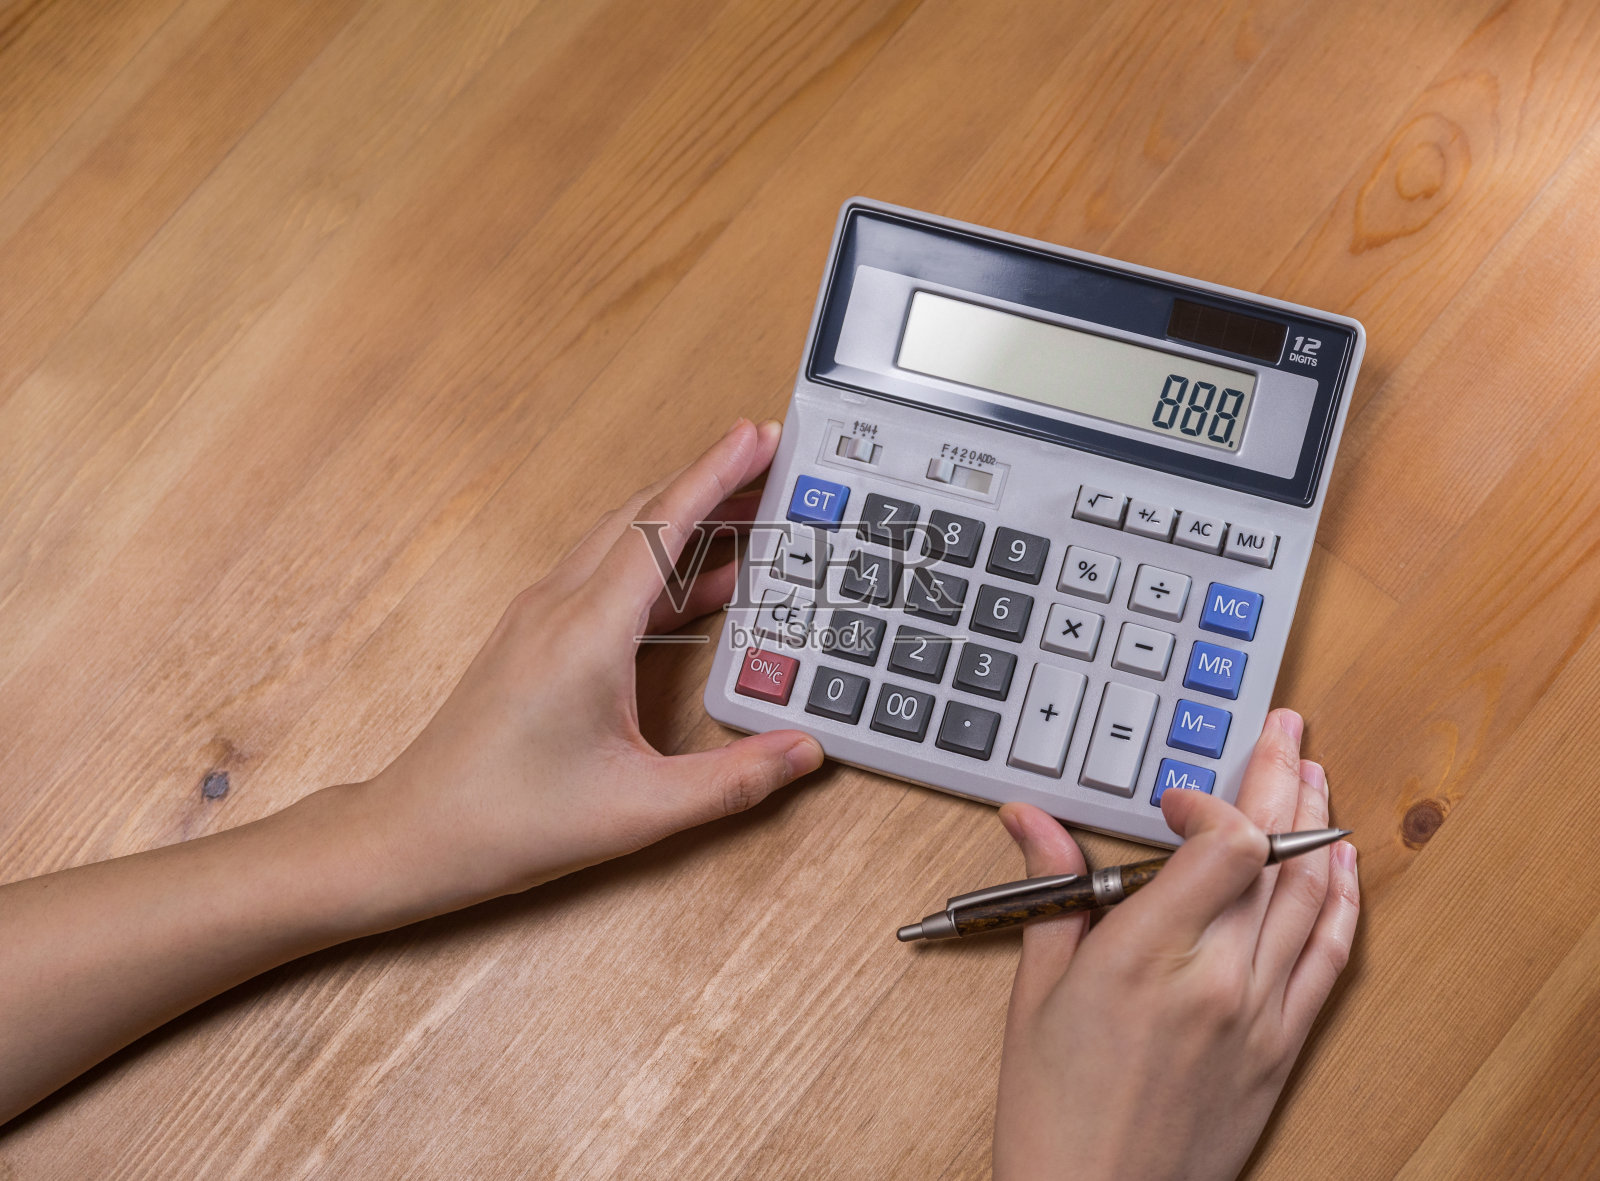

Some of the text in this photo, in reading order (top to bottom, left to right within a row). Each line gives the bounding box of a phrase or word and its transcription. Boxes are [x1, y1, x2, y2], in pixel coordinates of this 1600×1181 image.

[1293, 336, 1322, 356] 12
[1289, 352, 1318, 367] DIGITS
[951, 446, 959, 456] 4
[959, 448, 968, 459] 2
[803, 488, 836, 511] GT
[880, 504, 899, 527] 7
[943, 522, 962, 545] 8
[1189, 520, 1213, 538] AC
[1008, 539, 1027, 563] 9
[1236, 532, 1265, 550] MU
[861, 563, 880, 586] 4
[925, 579, 944, 603] 5
[771, 603, 801, 626] CE
[992, 596, 1011, 620] 6
[1213, 594, 1250, 620] MC
[849, 620, 860, 643] 1
[908, 636, 928, 662] 2
[750, 658, 783, 685] ON/C
[974, 652, 993, 677] 3
[1198, 652, 1233, 678] MR
[827, 678, 845, 701] 0
[886, 692, 918, 720] 00
[1165, 769, 1201, 791] M+
